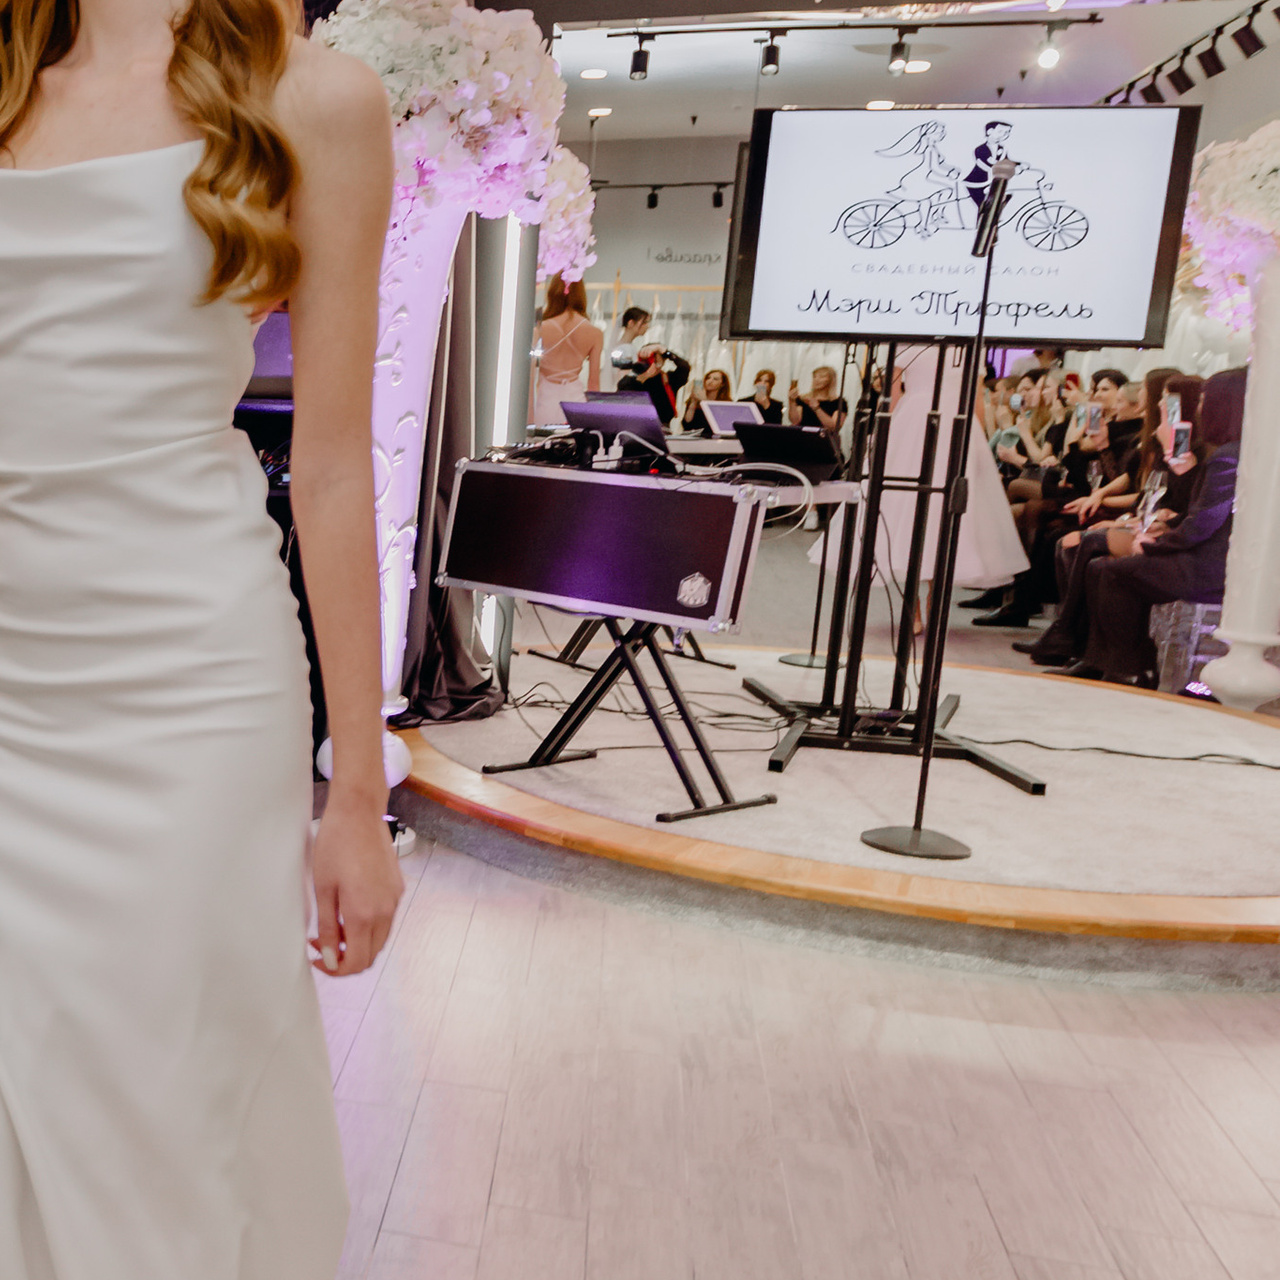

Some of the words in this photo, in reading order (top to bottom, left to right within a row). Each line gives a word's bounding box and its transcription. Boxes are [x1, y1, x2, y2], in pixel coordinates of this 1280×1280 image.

[850, 262, 977, 275] СВАДЕБНЫЙ
[797, 289, 902, 324] Мэри
[910, 289, 1094, 327] Трюфель
